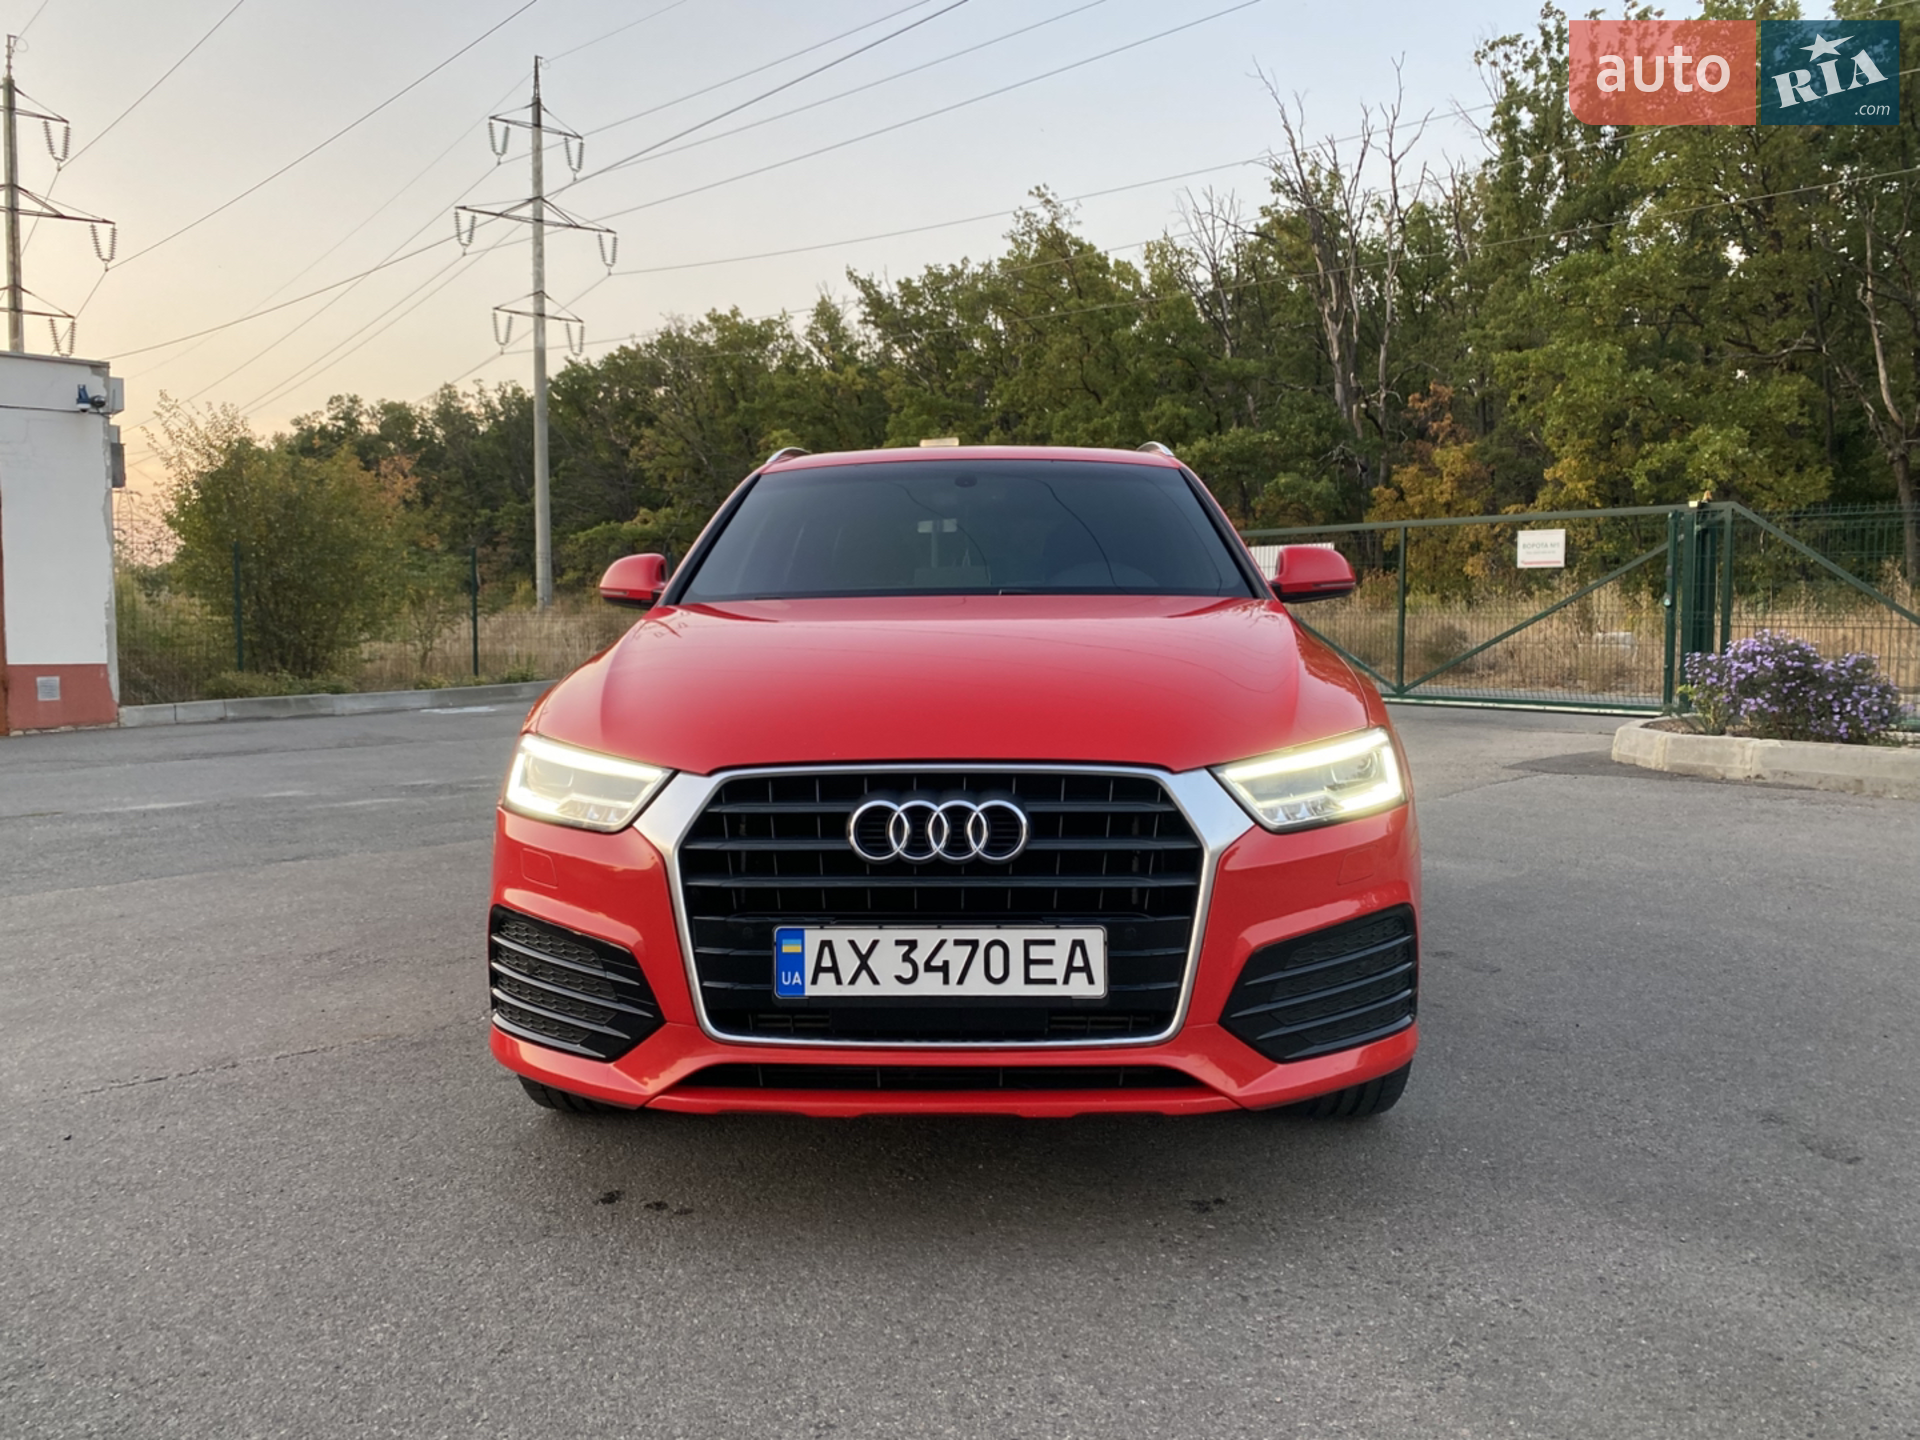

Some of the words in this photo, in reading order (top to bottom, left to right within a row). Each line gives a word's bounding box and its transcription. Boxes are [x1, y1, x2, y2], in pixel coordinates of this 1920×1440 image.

[1522, 542, 1549, 550] ВОРОТА
[810, 939, 881, 986] AX
[894, 939, 1010, 986] 3470
[1023, 939, 1096, 986] EA
[781, 971, 803, 986] UA
